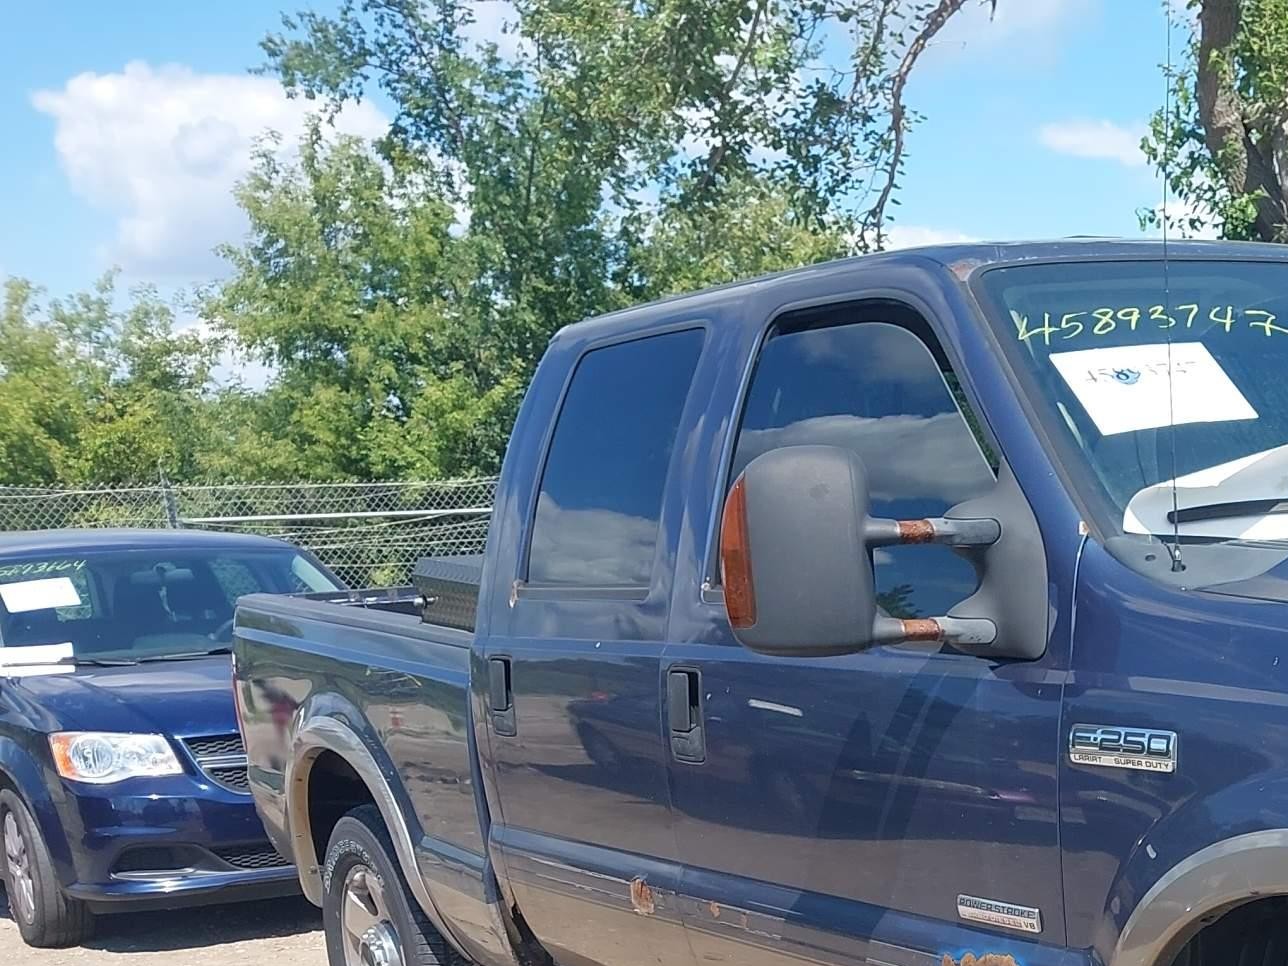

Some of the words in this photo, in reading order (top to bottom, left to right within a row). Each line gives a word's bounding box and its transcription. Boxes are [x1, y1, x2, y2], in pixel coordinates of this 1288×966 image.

[1073, 753, 1102, 764] LARIAT
[1113, 757, 1143, 768] SUPER
[1145, 761, 1170, 770] DUTY
